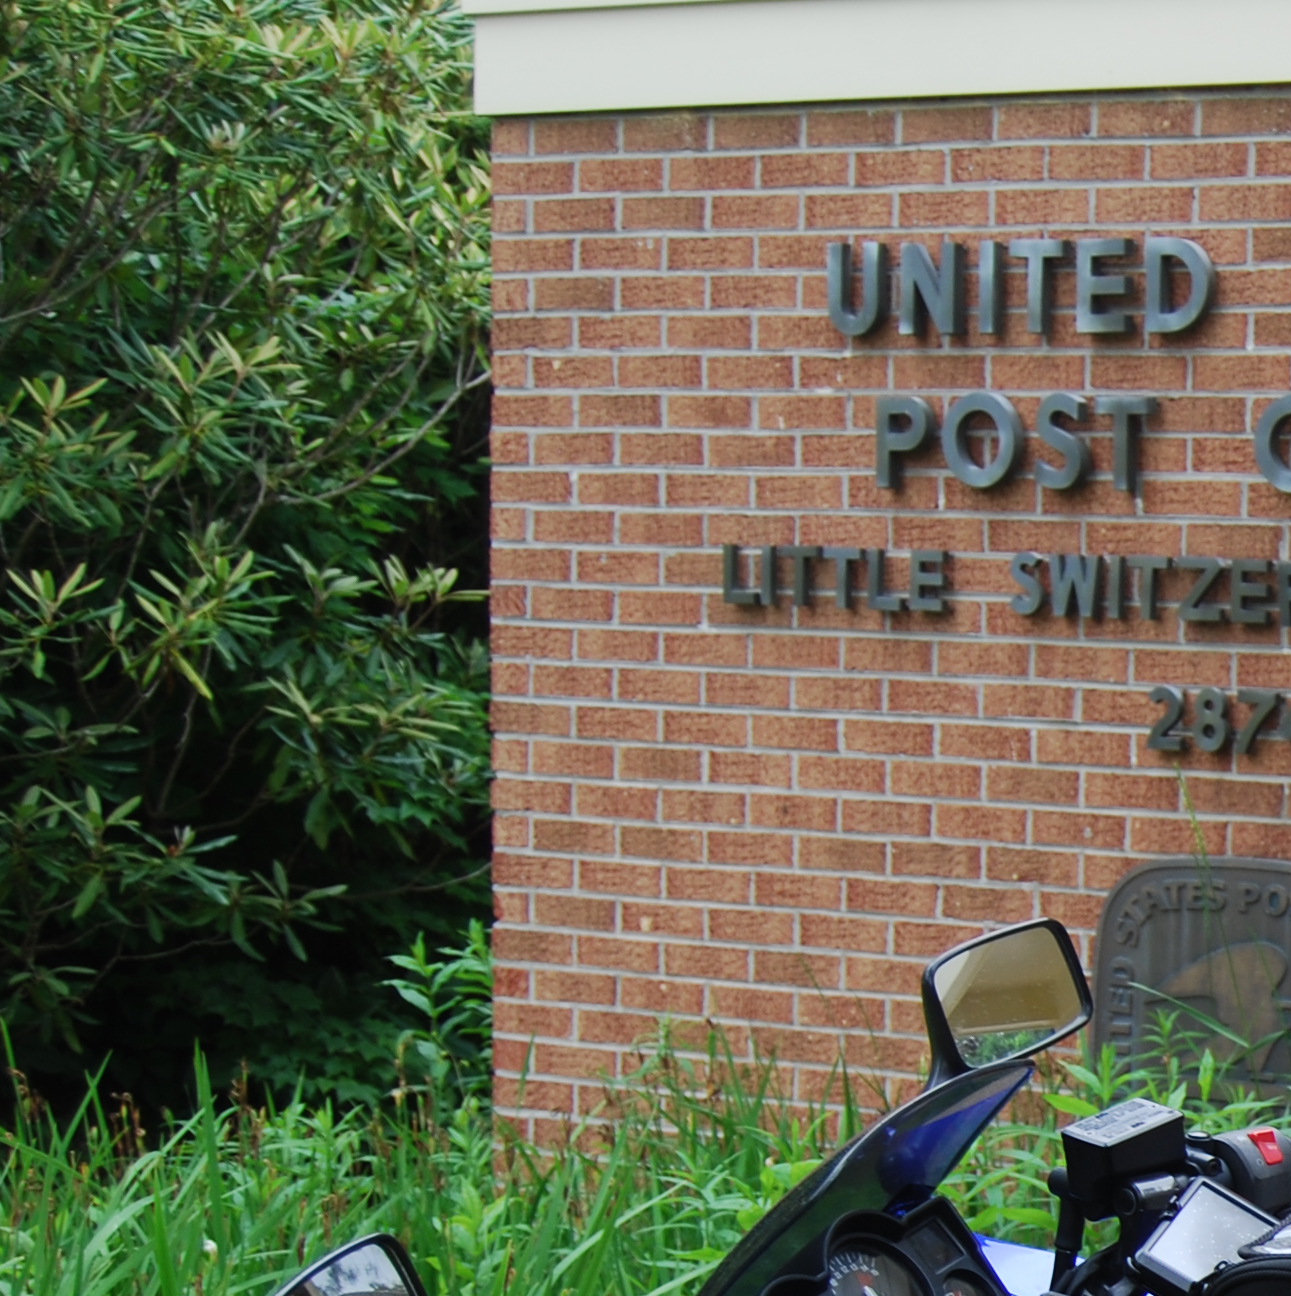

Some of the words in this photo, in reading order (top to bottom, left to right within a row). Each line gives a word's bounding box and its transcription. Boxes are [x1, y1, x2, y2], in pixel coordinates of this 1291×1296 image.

[827, 236, 1216, 336] UNITED
[876, 391, 1156, 491] POST
[722, 544, 947, 612] LITTLE
[1114, 879, 1227, 948] STATES
